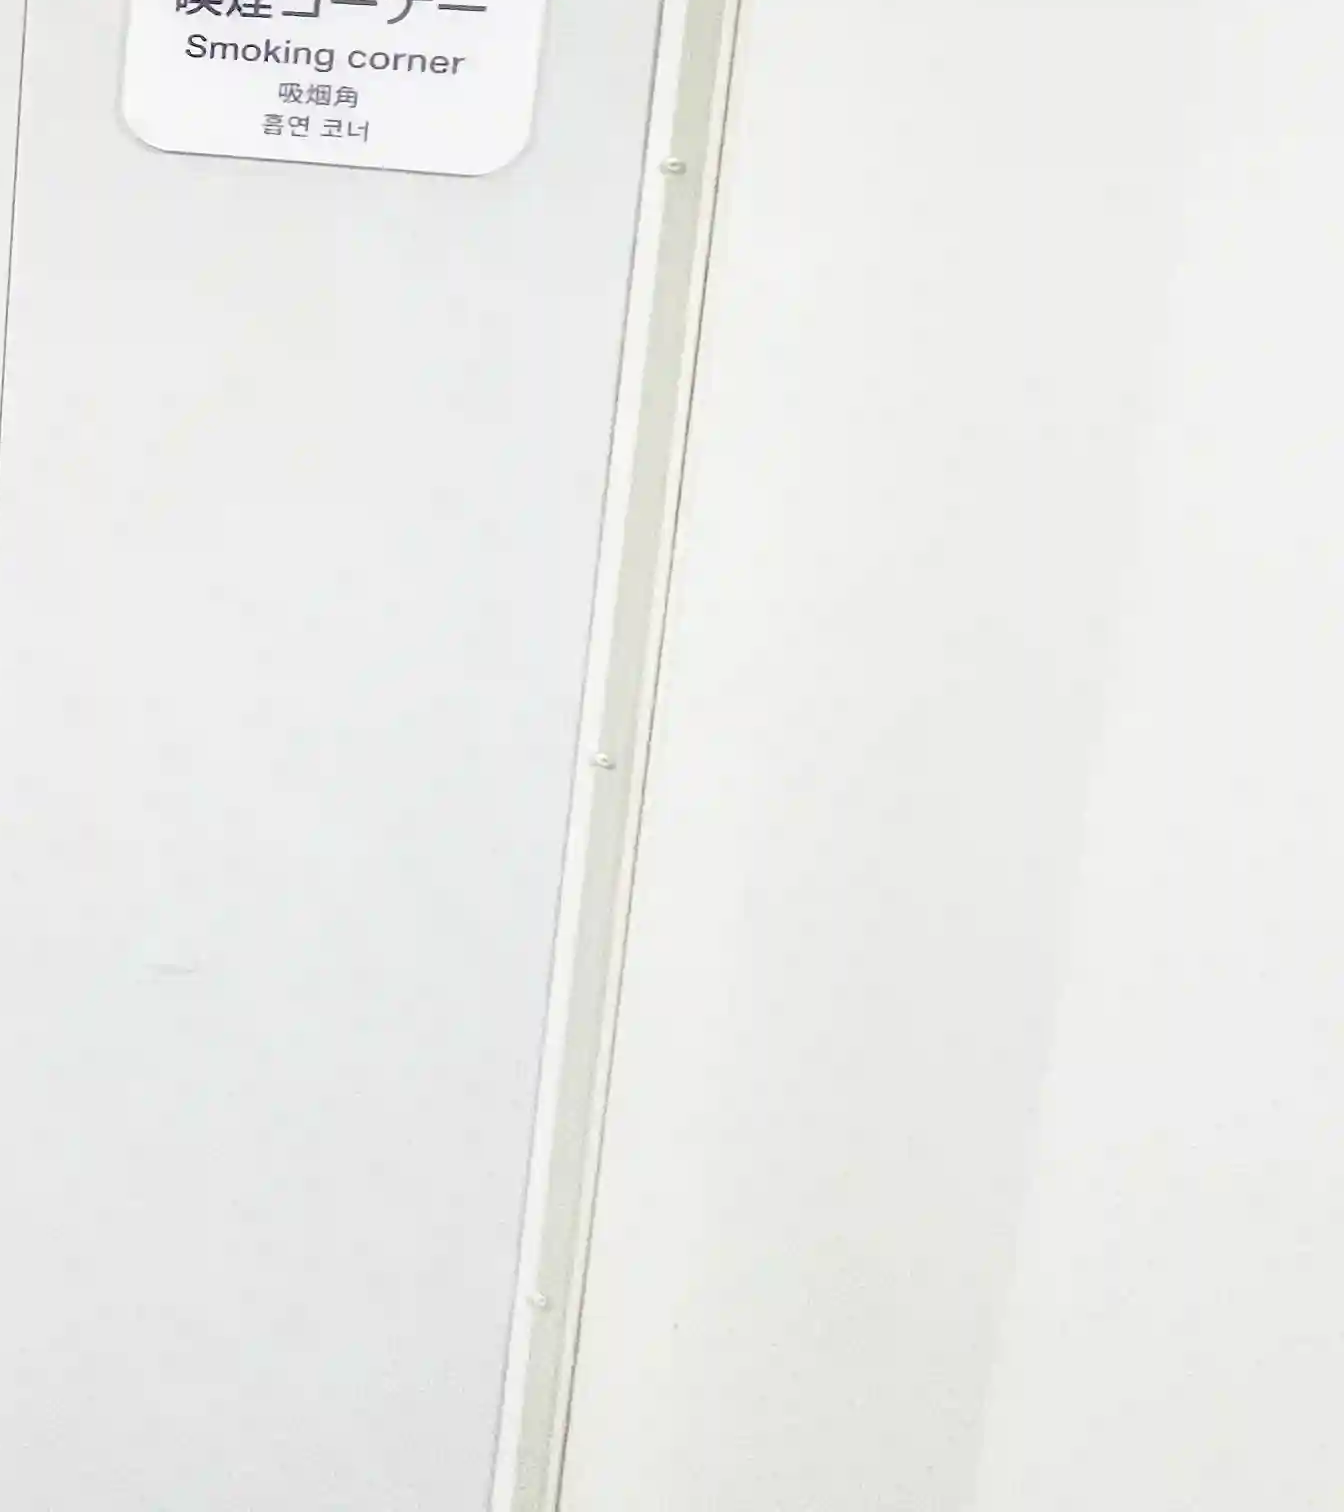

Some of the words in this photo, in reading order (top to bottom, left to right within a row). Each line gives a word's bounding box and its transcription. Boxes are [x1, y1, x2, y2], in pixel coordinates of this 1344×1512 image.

[184, 33, 335, 73] Smoking
[347, 48, 467, 75] corner
[277, 82, 360, 108] 吸烟角
[261, 113, 311, 138] 흡연
[319, 118, 370, 143] 코너
